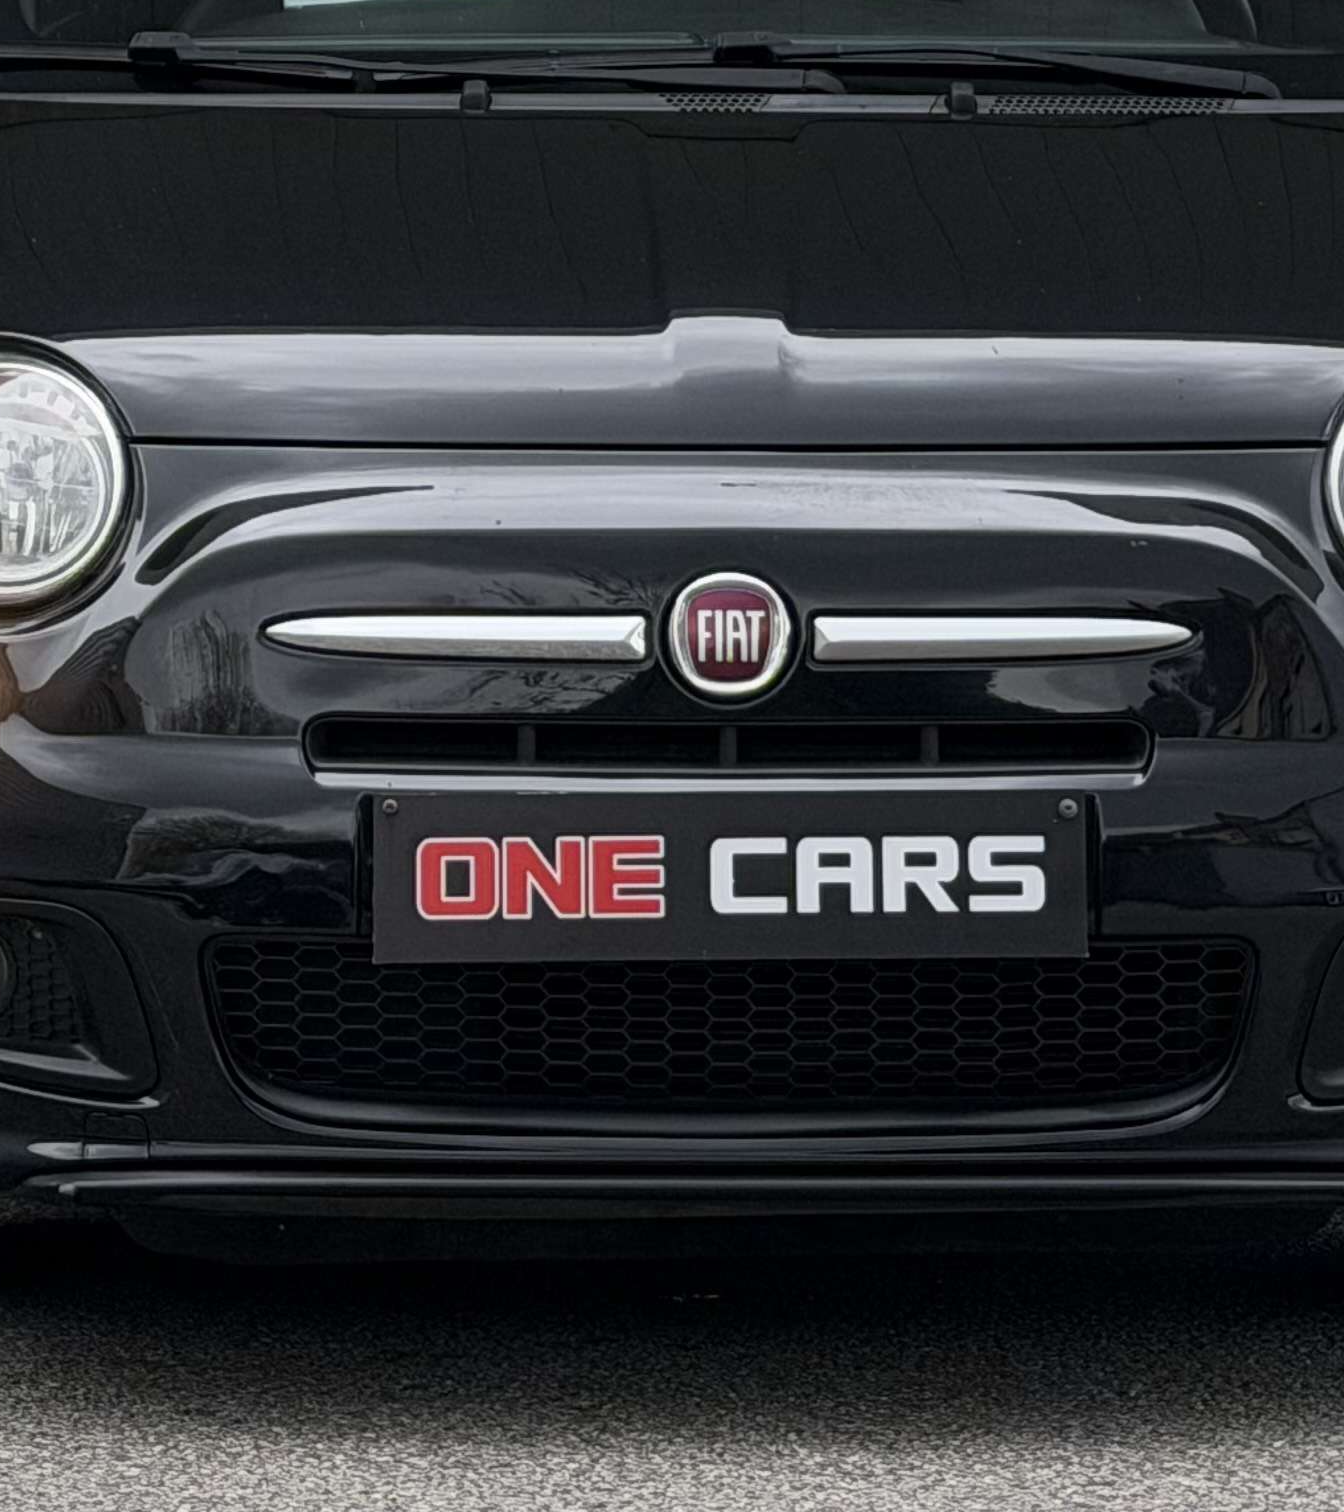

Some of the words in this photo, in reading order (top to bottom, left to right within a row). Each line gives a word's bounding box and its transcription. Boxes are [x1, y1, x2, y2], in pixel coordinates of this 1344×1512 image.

[697, 609, 766, 663] FIAT
[416, 835, 665, 920] ONE
[710, 835, 1046, 915] CARS
